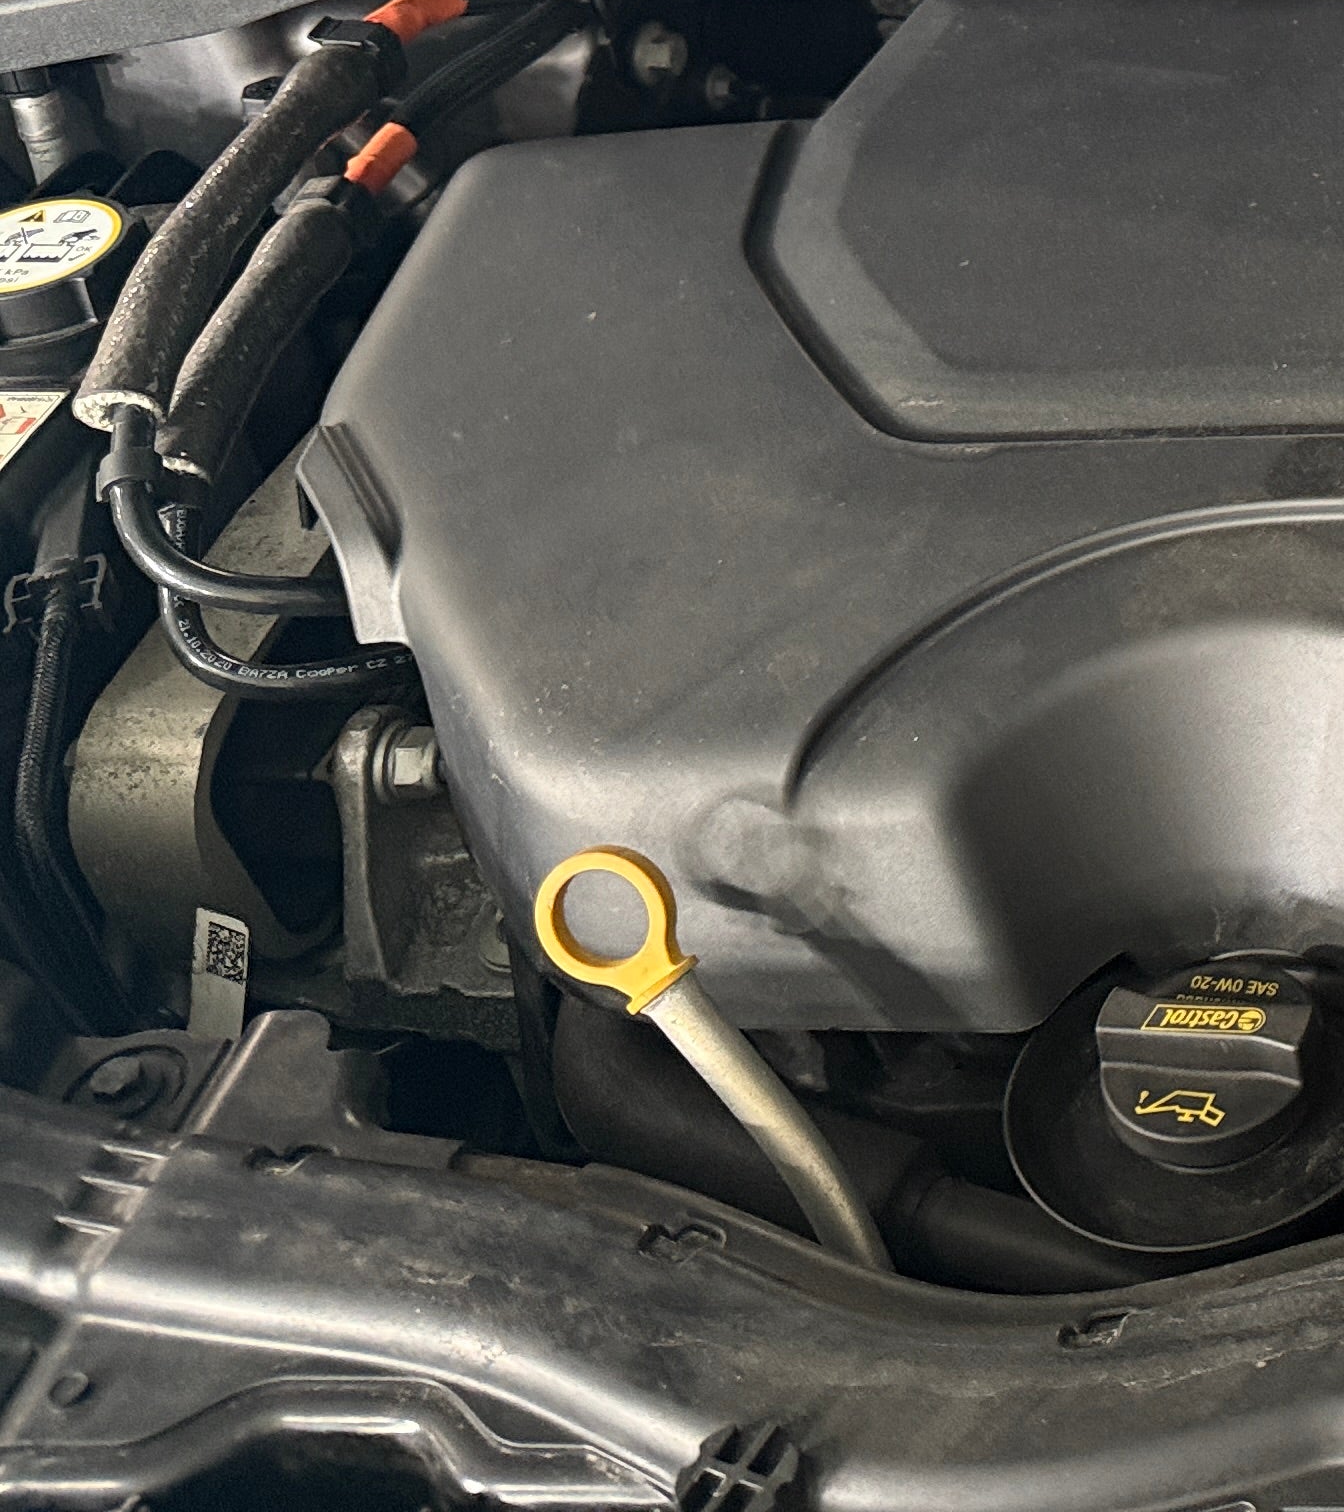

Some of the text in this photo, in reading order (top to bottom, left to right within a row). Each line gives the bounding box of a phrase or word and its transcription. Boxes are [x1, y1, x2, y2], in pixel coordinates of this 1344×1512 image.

[1190, 975, 1279, 996] SAE 0W-20
[1160, 1009, 1240, 1029] Castrol
